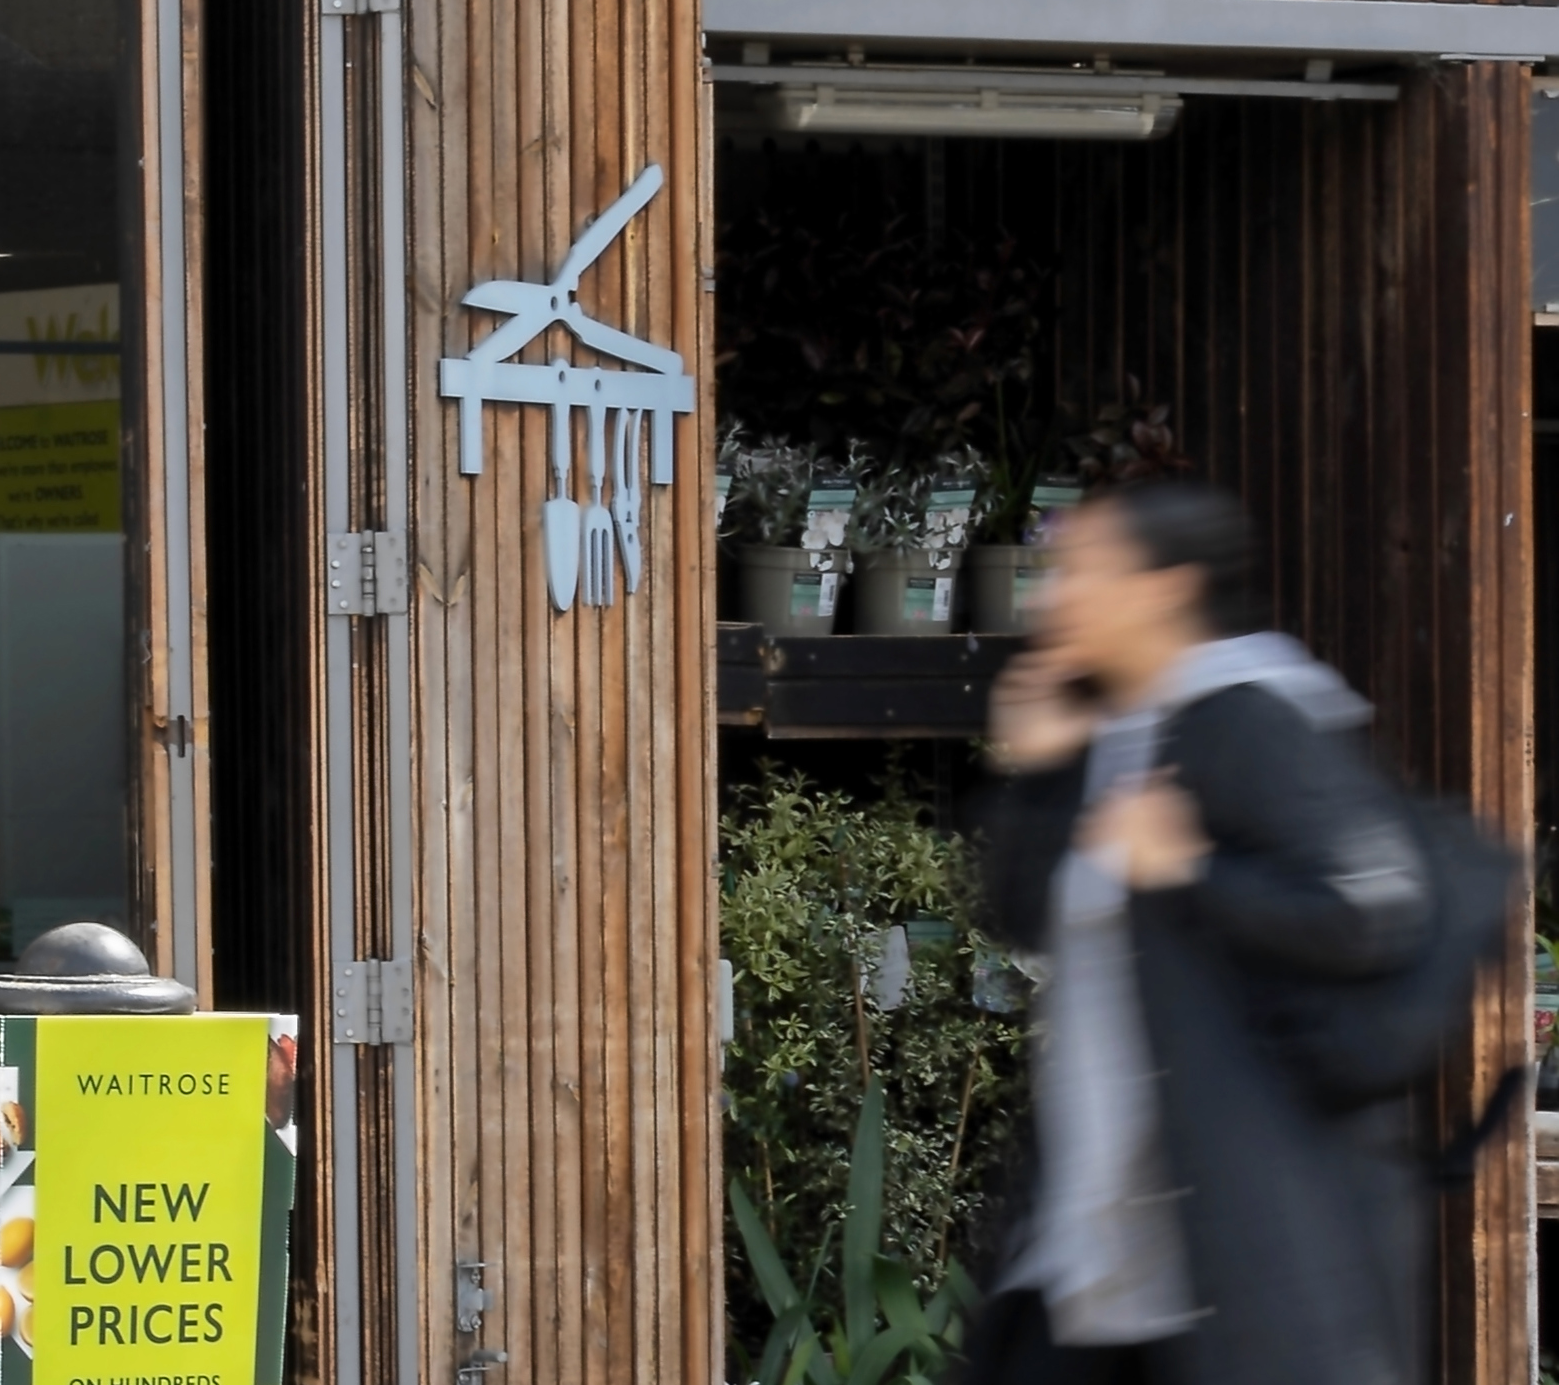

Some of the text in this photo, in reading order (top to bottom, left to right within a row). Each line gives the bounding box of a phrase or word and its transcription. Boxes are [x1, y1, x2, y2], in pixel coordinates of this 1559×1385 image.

[77, 1073, 231, 1096] WAITROSE
[94, 1182, 210, 1223] NEW
[64, 1243, 233, 1285] LOWER
[70, 1303, 223, 1346] PRICES
